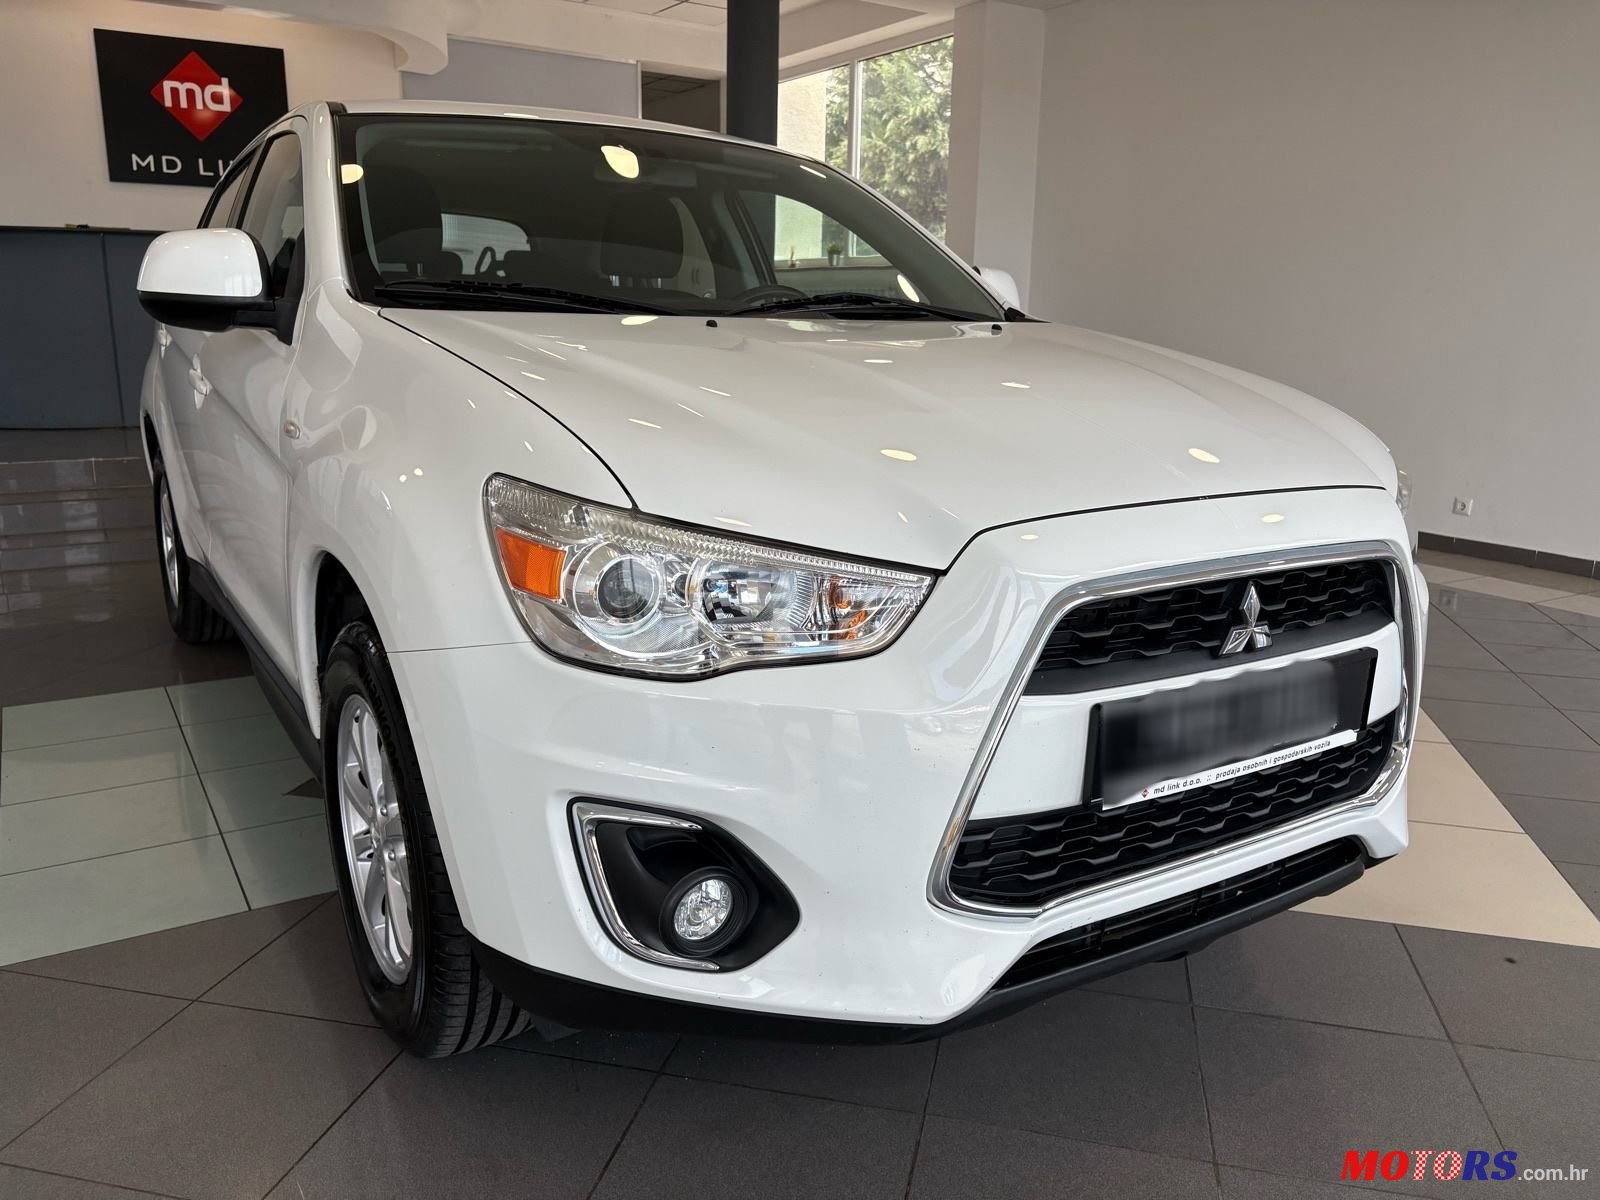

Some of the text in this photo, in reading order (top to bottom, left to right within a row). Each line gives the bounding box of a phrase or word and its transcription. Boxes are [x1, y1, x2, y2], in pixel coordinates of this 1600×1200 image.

[162, 77, 231, 112] md
[131, 153, 233, 176] MD LI
[1153, 785, 1165, 795] md
[1167, 781, 1181, 792] link
[1182, 777, 1202, 788] d.o.o.
[1215, 767, 1241, 781] prodaja
[1242, 759, 1268, 772] osobnih
[1273, 746, 1313, 765] gospodarskih
[1313, 740, 1331, 752] vozila
